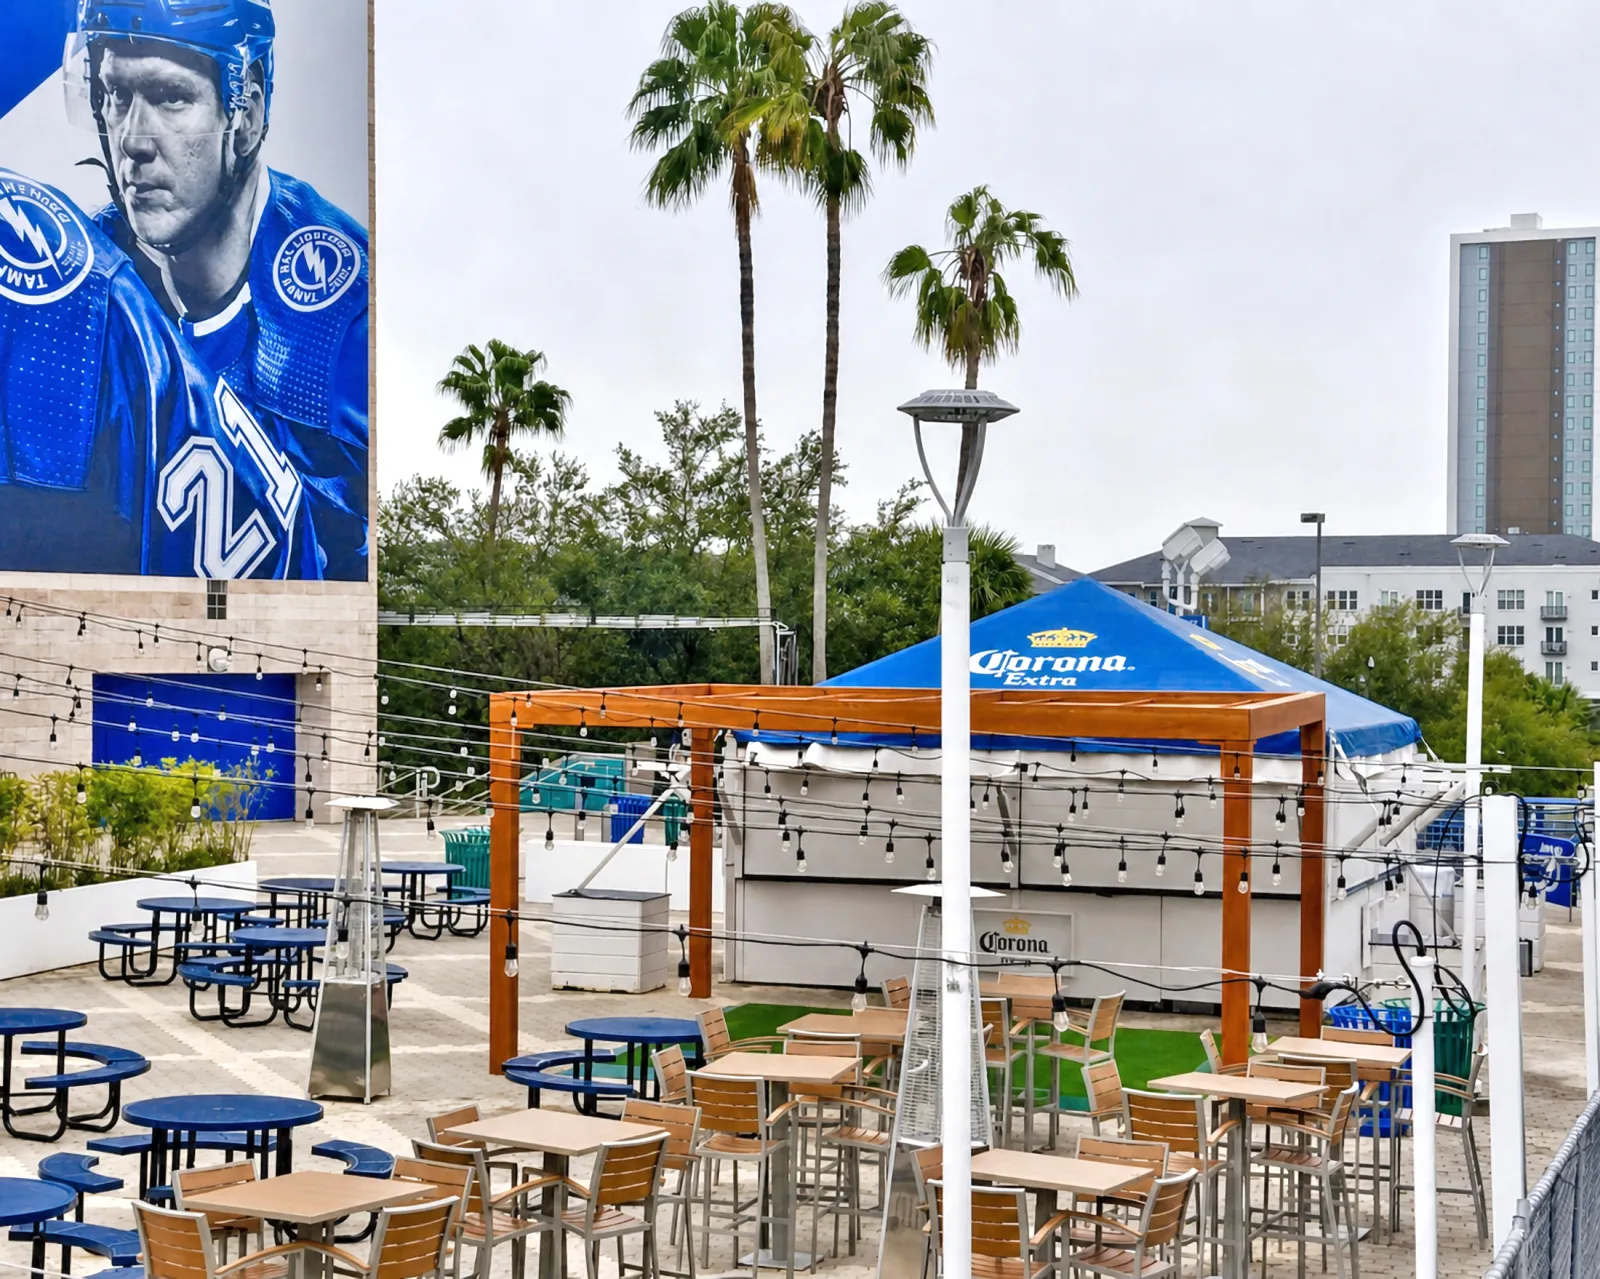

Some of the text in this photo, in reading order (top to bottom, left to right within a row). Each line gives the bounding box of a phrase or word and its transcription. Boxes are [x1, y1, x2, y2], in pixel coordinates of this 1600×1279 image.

[157, 375, 302, 579] 21
[969, 649, 1127, 678] Corona
[1003, 672, 1077, 686] Extra
[979, 931, 1048, 954] Corona
